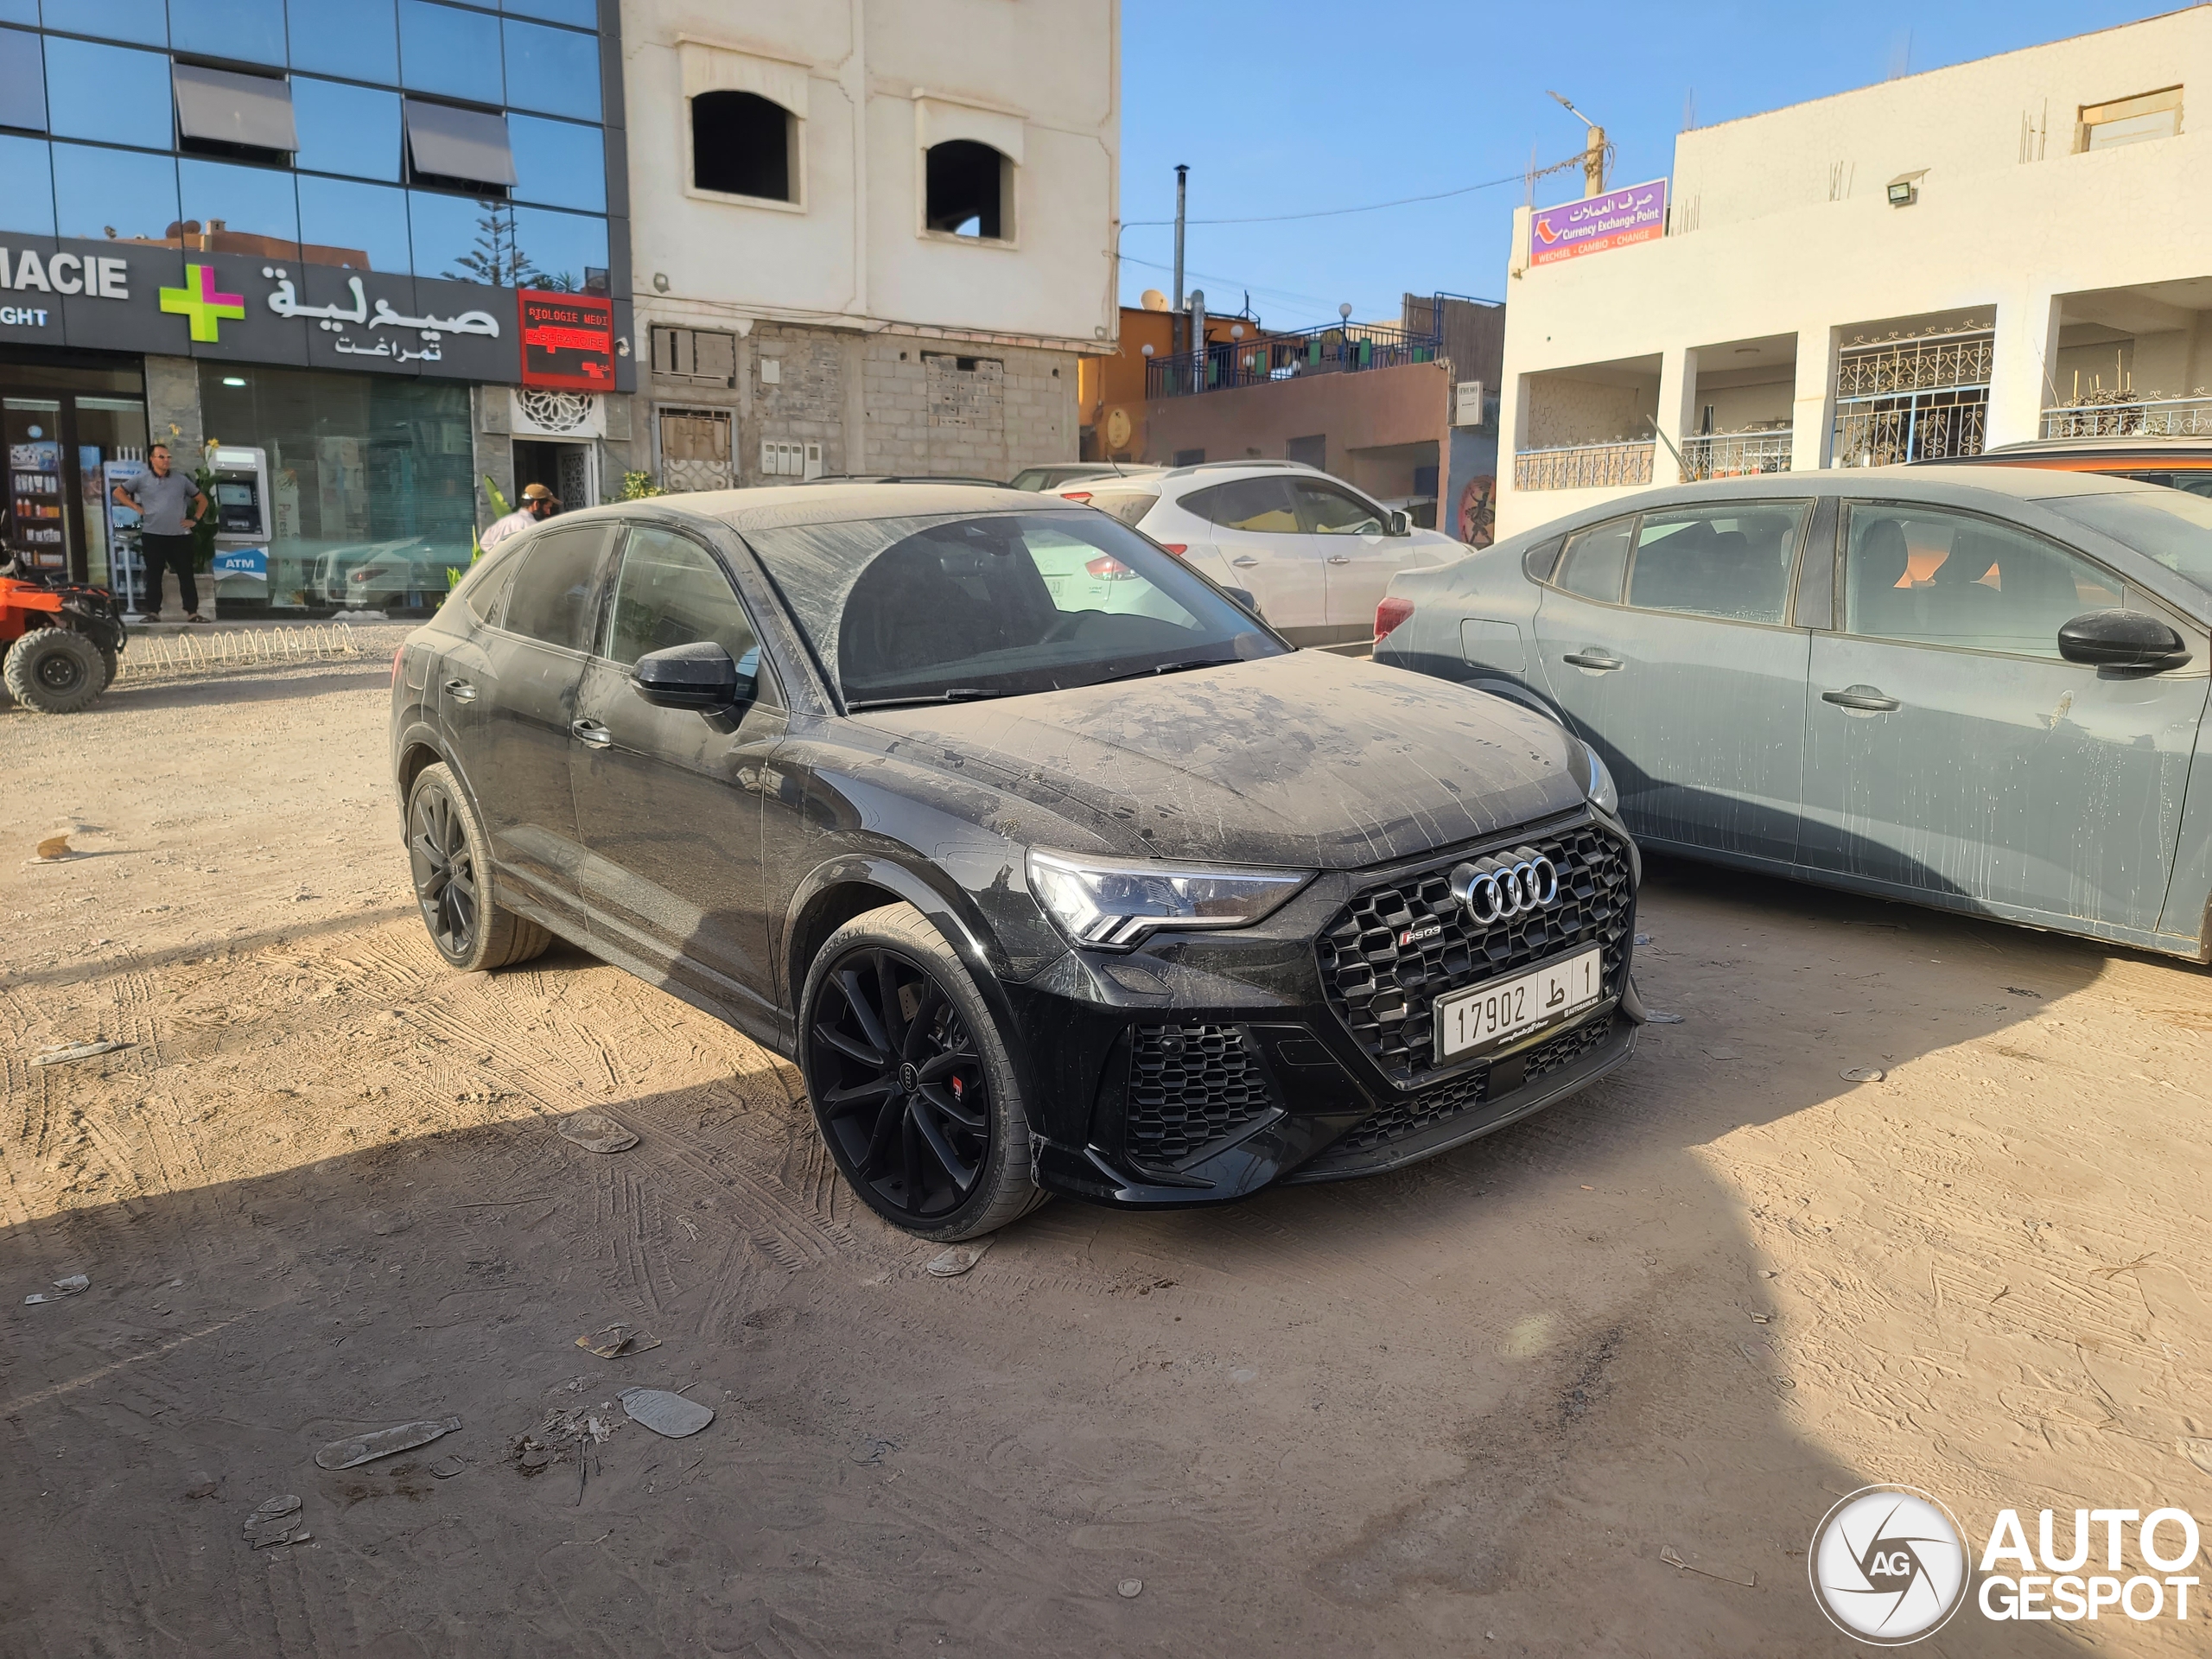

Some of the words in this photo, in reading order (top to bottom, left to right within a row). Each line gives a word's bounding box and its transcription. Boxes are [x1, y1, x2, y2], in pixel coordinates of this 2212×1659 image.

[1569, 198, 1615, 222] العملات
[1618, 192, 1654, 212] صرف
[1562, 224, 1596, 240] Currency
[1598, 215, 1635, 232] Exchange
[1637, 207, 1660, 222] Point
[1538, 249, 1571, 264] WECHSEL
[1578, 239, 1608, 254] CAMBIO
[1617, 230, 1650, 245] CHANGE
[262, 266, 499, 339] صيدلية
[529, 307, 579, 323] BIOLOGIE
[583, 314, 608, 326] MEDI
[335, 337, 442, 363] تمراغت
[225, 559, 255, 569] ATM
[1458, 986, 1525, 1044] 17902
[1546, 978, 1565, 1008] ط
[1585, 961, 1590, 995] 1
